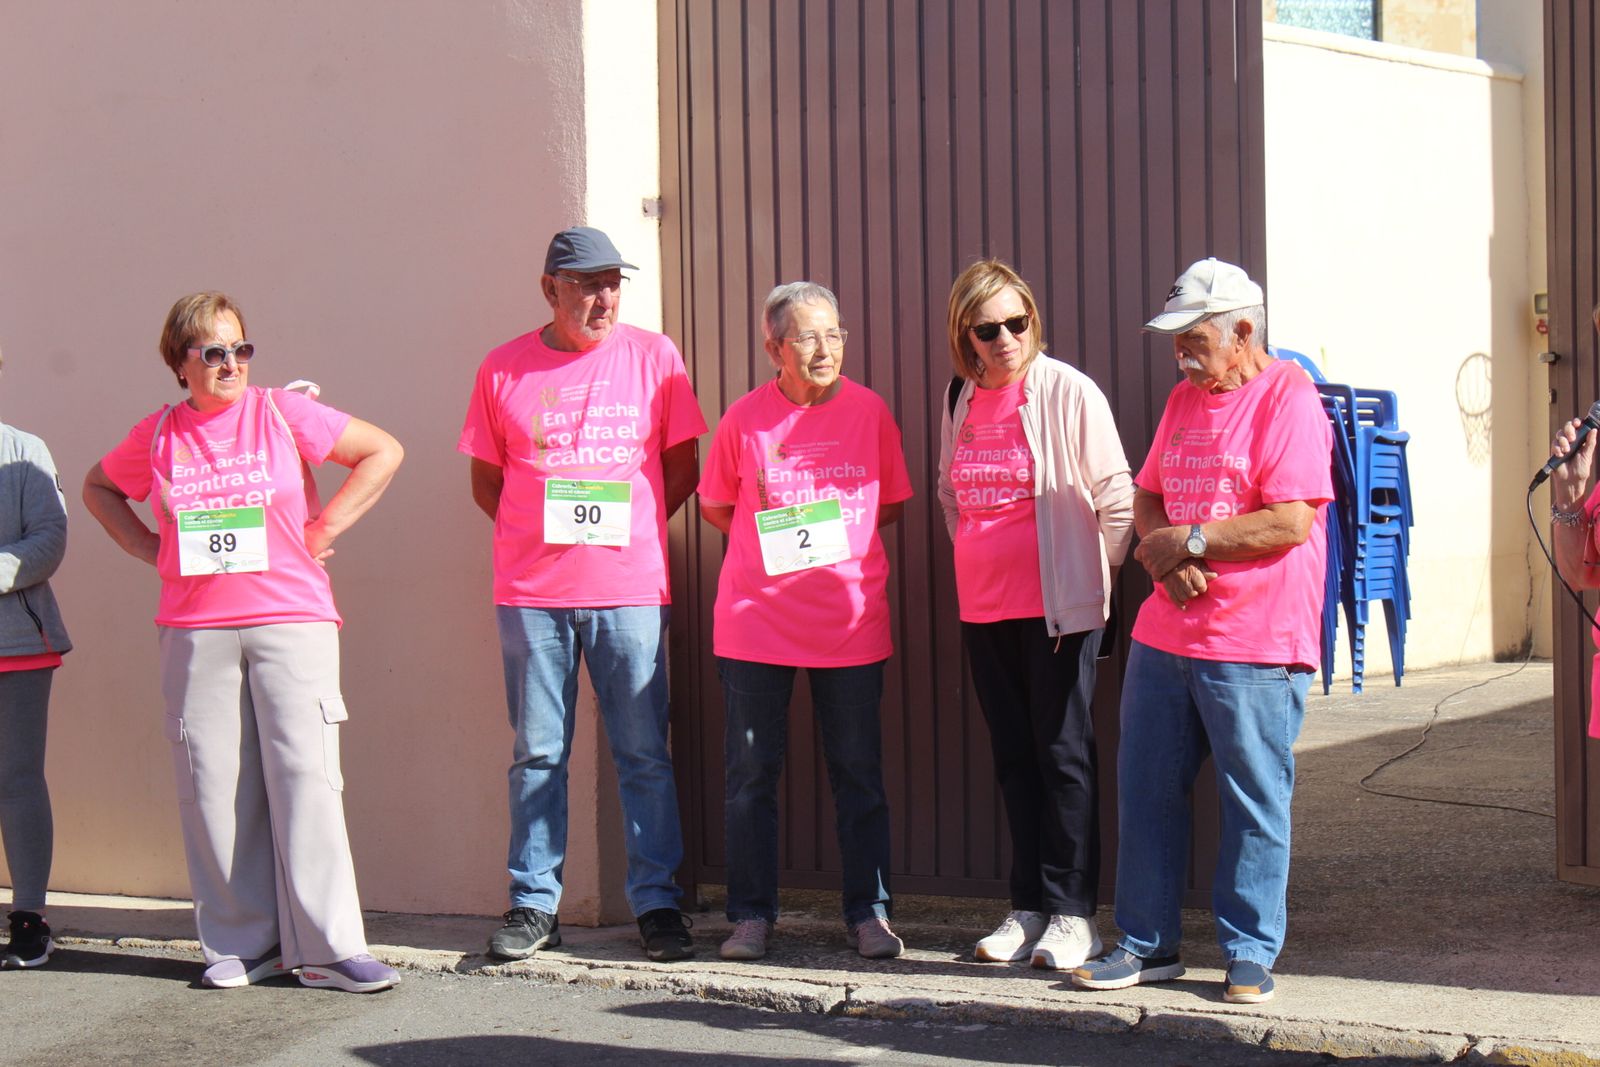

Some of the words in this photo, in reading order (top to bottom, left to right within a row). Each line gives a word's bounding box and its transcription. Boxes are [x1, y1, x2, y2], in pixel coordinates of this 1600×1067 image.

[543, 412, 566, 427] En
[572, 402, 640, 423] marcha
[546, 426, 614, 448] contra
[617, 421, 638, 440] el
[172, 465, 196, 478] En
[200, 449, 267, 476] marcha
[546, 445, 637, 468] cáncer
[954, 446, 972, 460] En
[977, 444, 1033, 462] march
[1162, 450, 1180, 467] En
[1186, 451, 1246, 470] marcha
[170, 472, 244, 498] contra
[248, 464, 272, 484] el
[768, 468, 792, 484] En
[798, 462, 866, 480] marcha
[950, 465, 1012, 482] contra
[1163, 474, 1216, 494] contra
[1218, 474, 1242, 494] el
[173, 488, 276, 514] cáncer
[768, 484, 840, 505] contra
[844, 482, 864, 500] el
[574, 504, 601, 524] 90
[209, 532, 236, 553] 89
[796, 529, 812, 549] 2
